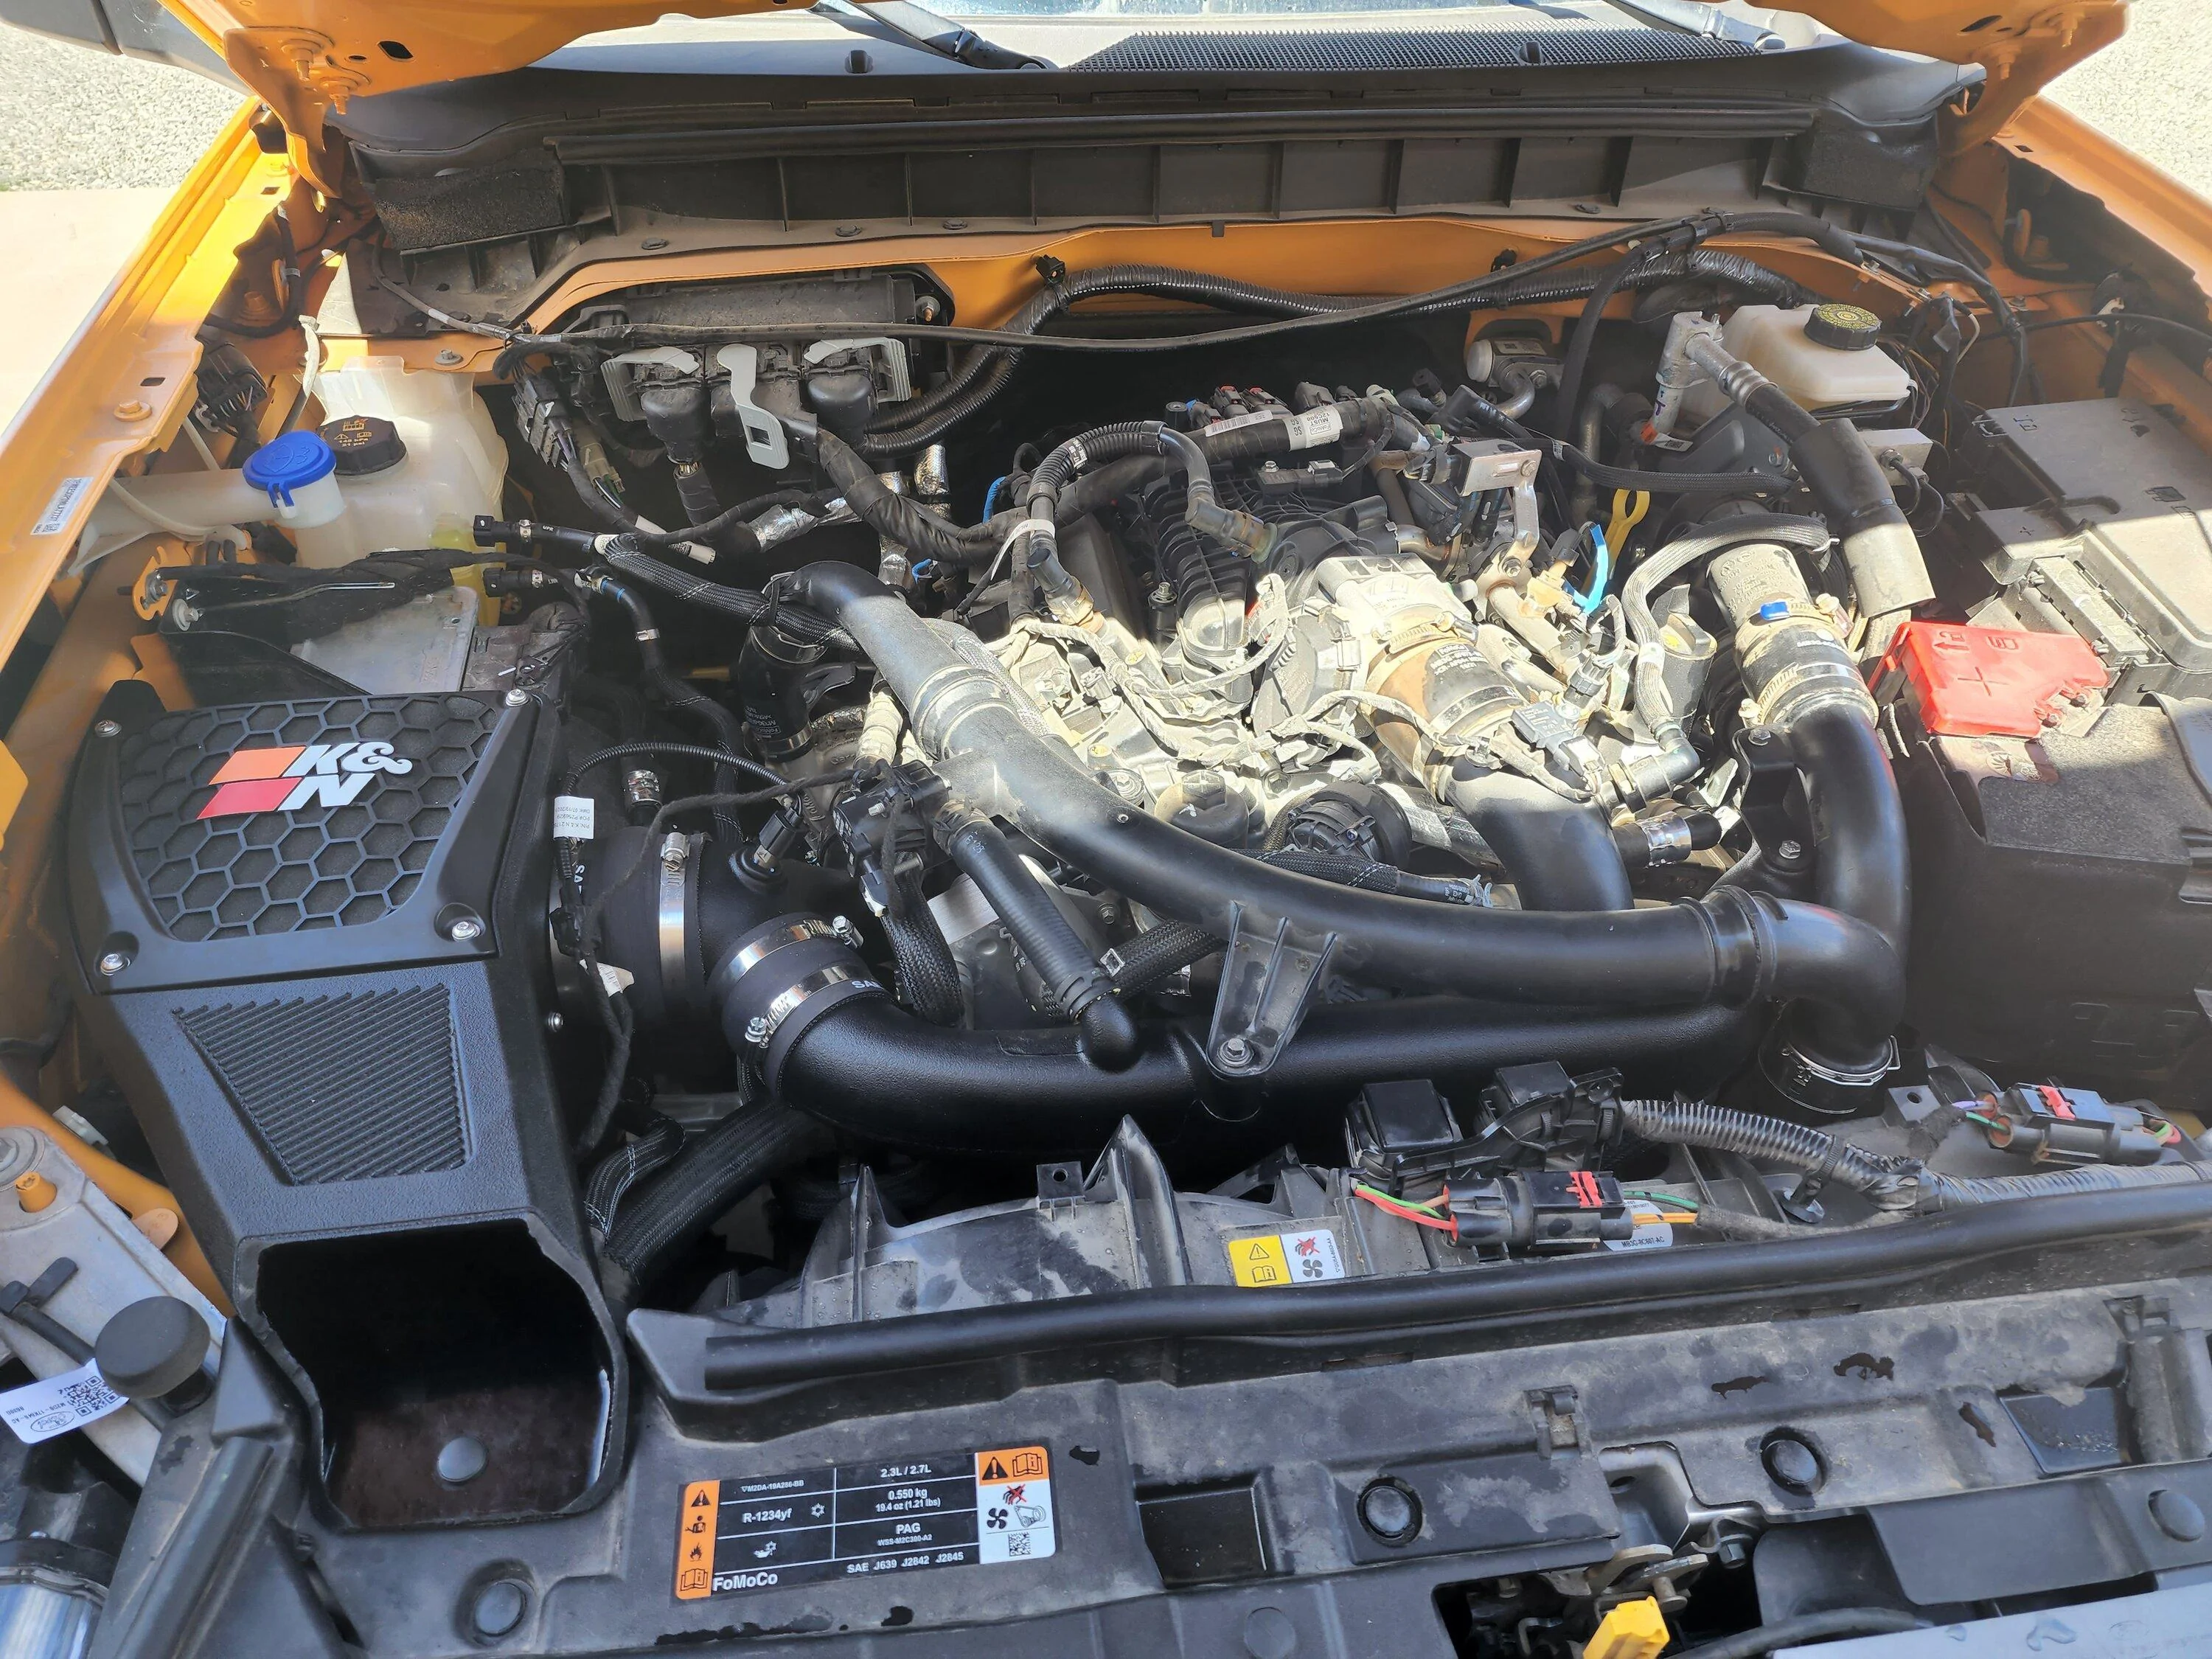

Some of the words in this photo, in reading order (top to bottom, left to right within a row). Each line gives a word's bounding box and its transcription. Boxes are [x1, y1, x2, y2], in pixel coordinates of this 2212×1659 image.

[1310, 417, 1329, 425] MUST
[880, 1467, 902, 1478] 2.3L
[903, 1466, 909, 1476] /
[909, 1464, 932, 1475] 2.7L
[887, 1488, 914, 1500] 0.550
[915, 1487, 928, 1500] kg
[875, 1501, 892, 1513] 19.4
[893, 1503, 904, 1511] oz
[905, 1499, 924, 1512] (1.21
[924, 1497, 942, 1508] lbs)
[742, 1508, 793, 1524] R-1234yf
[895, 1522, 921, 1535] PAG
[846, 1562, 869, 1573] SAE
[873, 1559, 897, 1571] J639
[901, 1555, 930, 1568] J2842
[935, 1551, 964, 1564] J2845
[712, 1572, 779, 1593] FoMoCo
